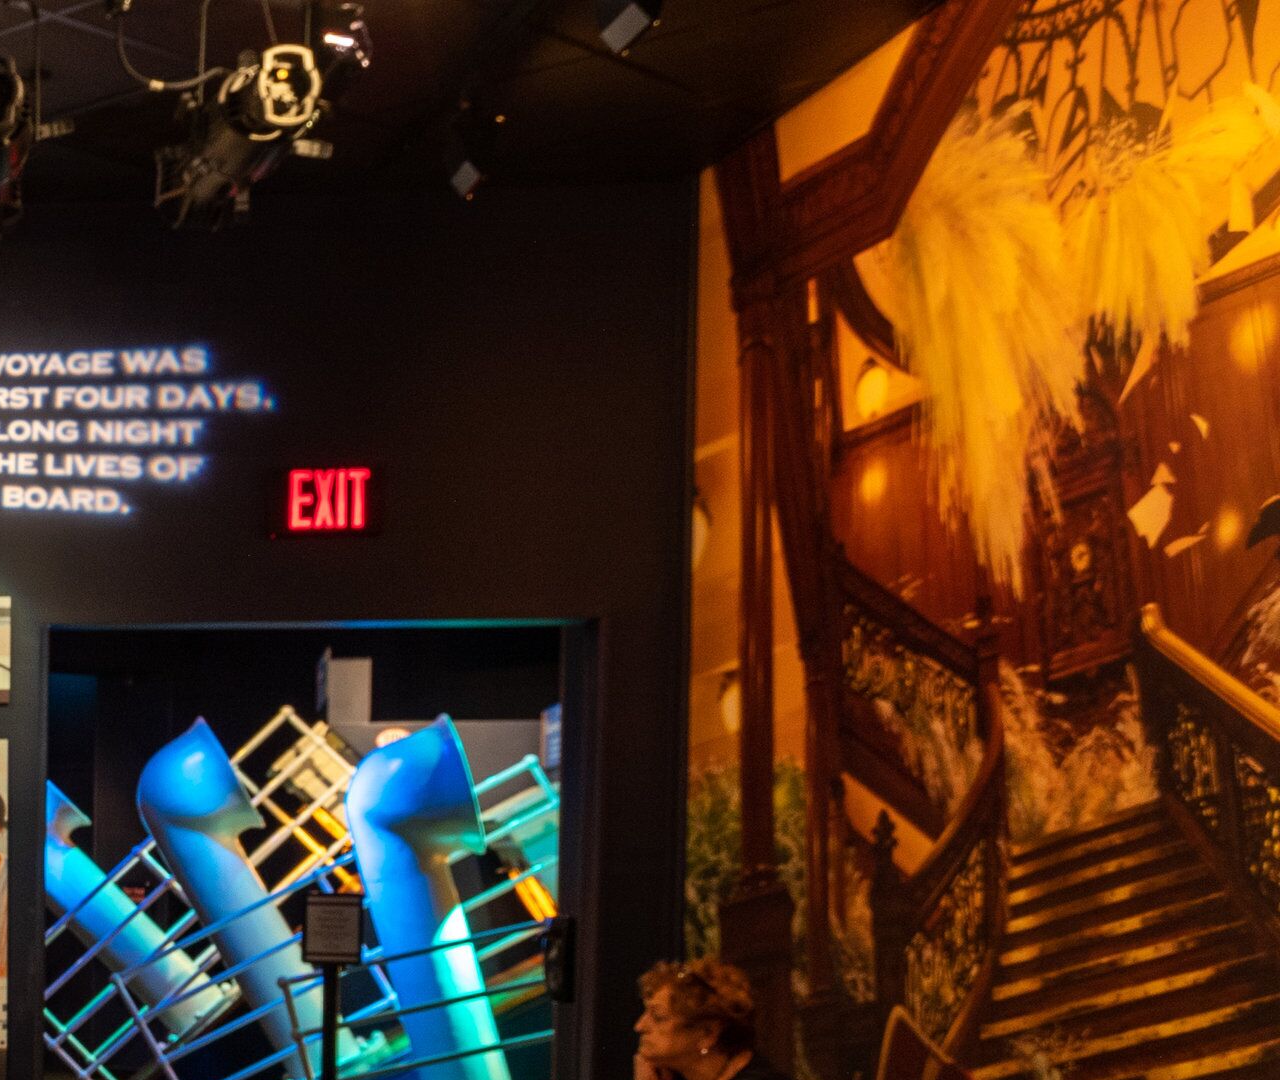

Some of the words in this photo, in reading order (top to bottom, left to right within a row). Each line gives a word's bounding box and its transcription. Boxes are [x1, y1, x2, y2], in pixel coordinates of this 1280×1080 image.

[120, 346, 208, 375] WAS
[54, 384, 150, 410] FOUR
[156, 381, 275, 413] DAYS.
[87, 419, 205, 447] NIGHT
[44, 454, 144, 479] LIVES
[147, 456, 207, 482] OF
[1, 486, 130, 515] BOARD.
[288, 467, 371, 530] EXIT
